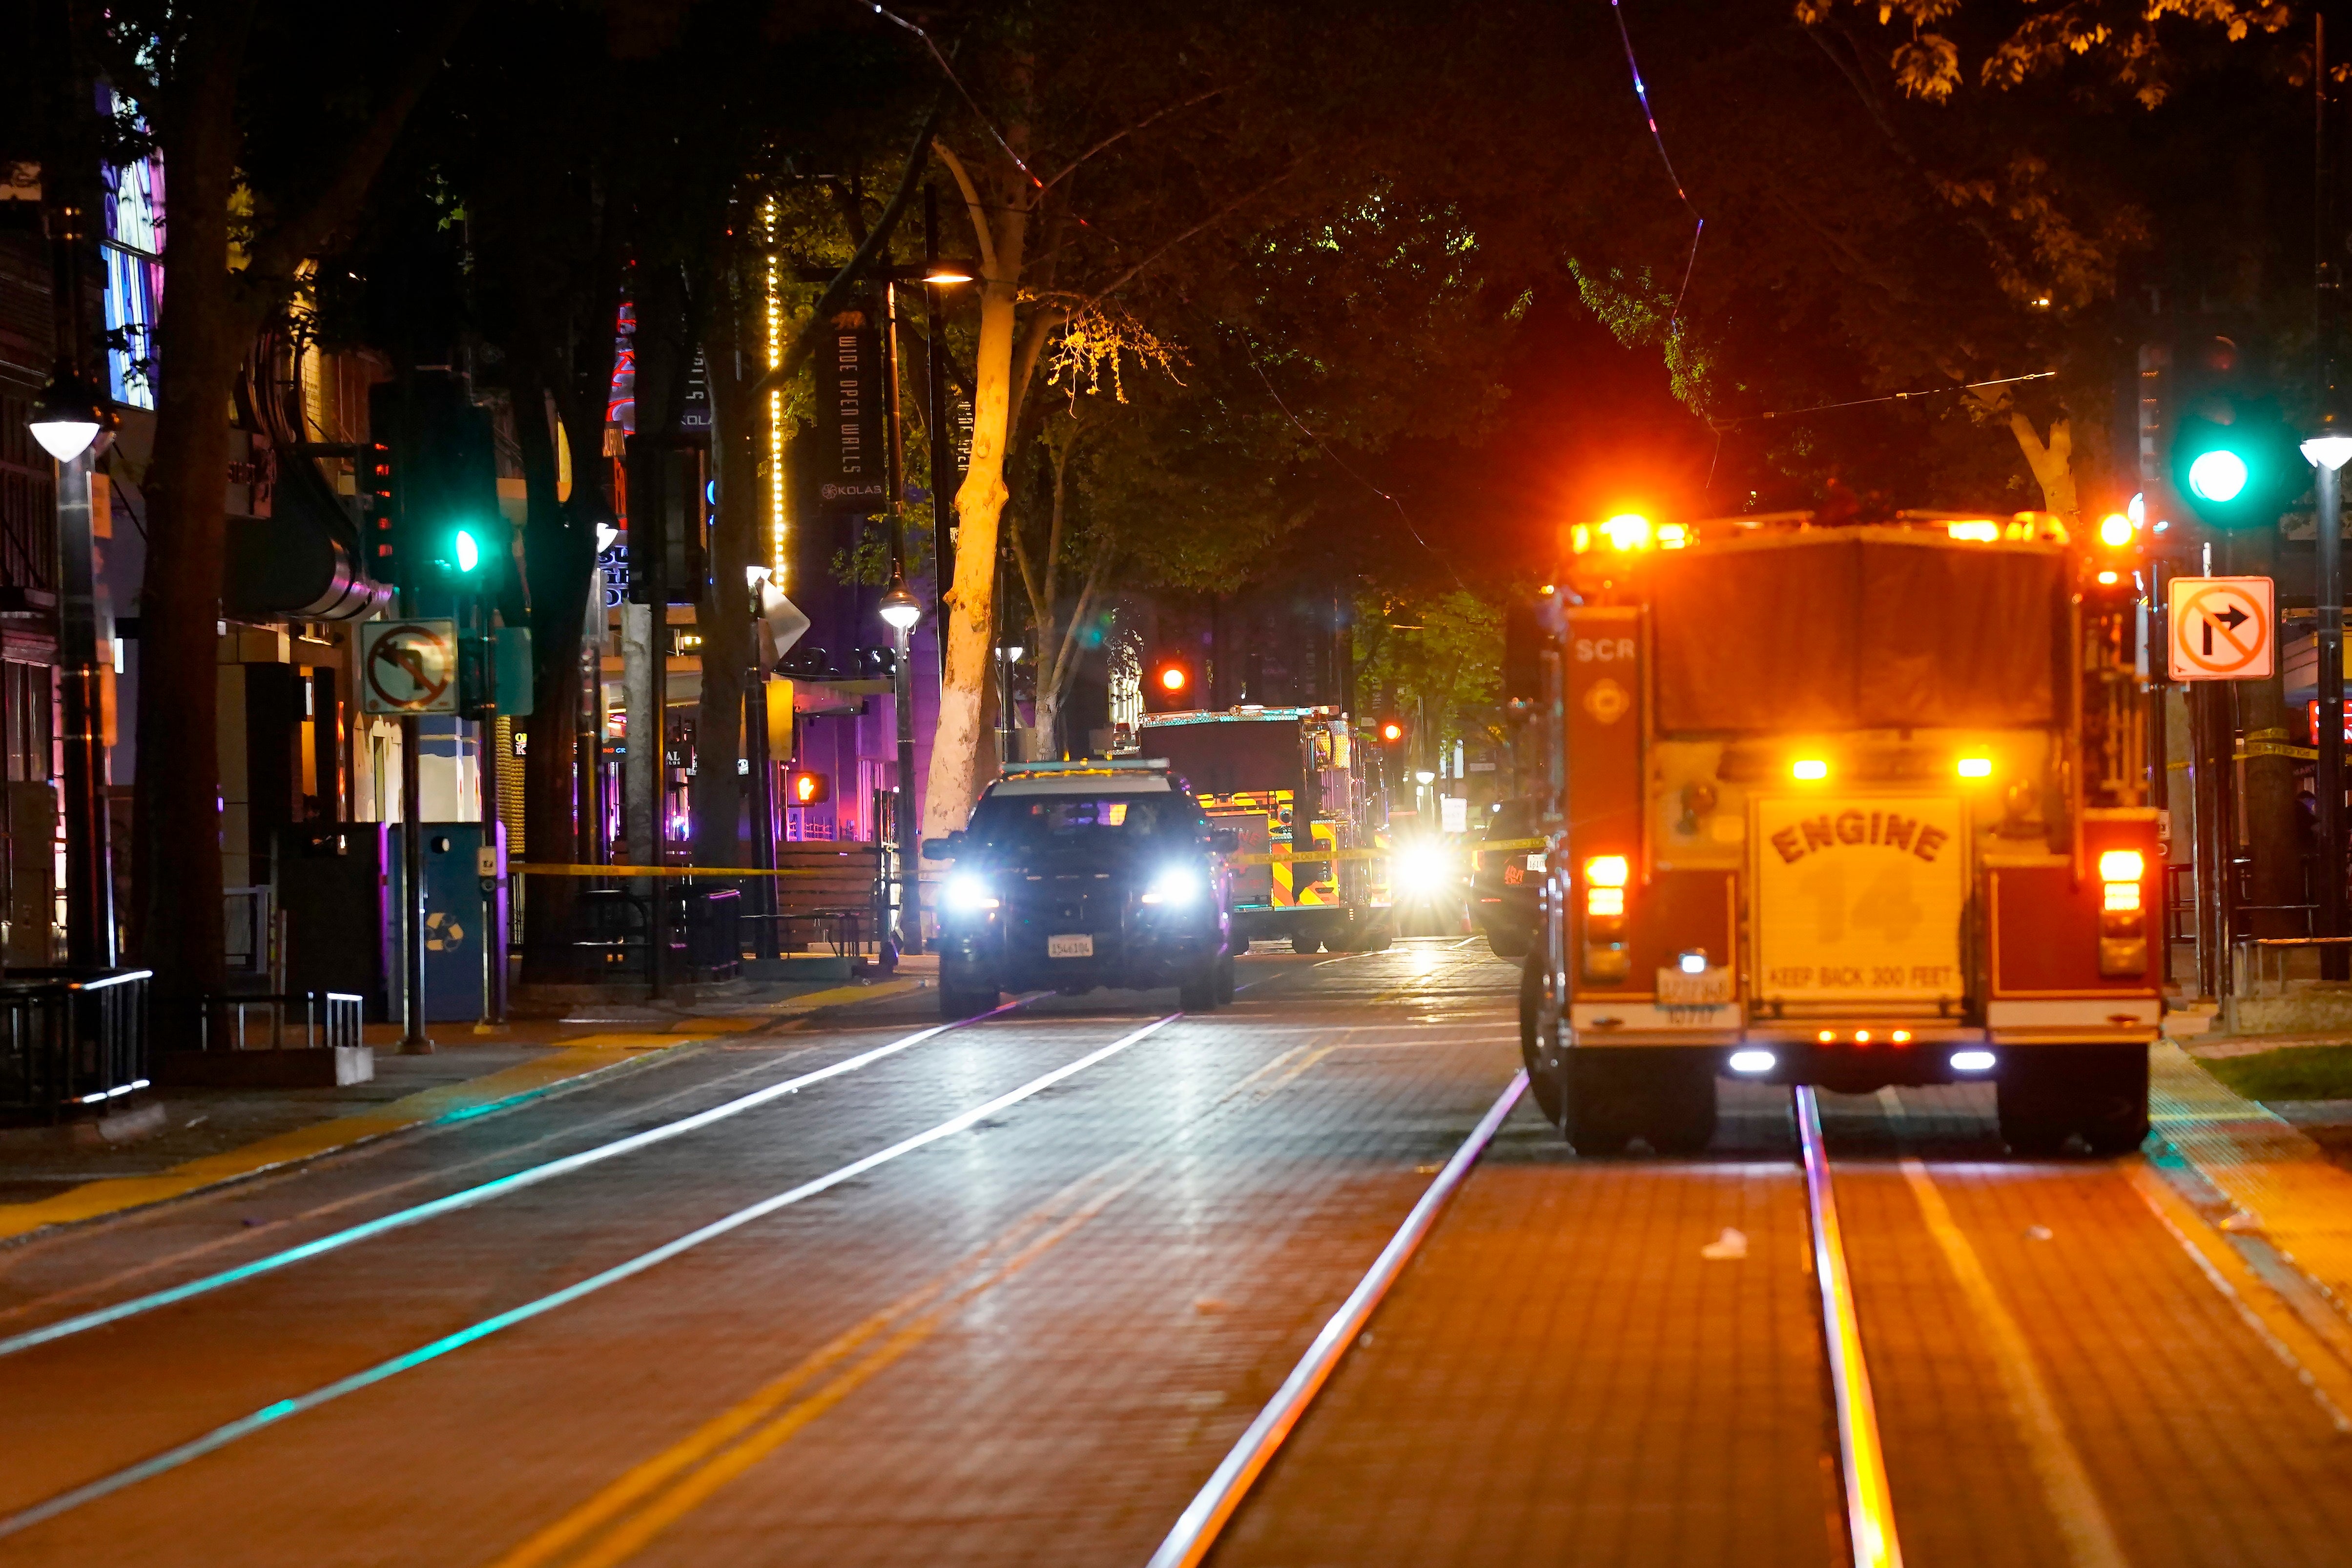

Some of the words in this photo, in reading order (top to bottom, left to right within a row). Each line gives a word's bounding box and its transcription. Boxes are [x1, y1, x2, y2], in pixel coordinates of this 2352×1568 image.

[839, 336, 858, 371] WIDE
[840, 380, 859, 415] OPEN
[841, 424, 861, 473] WALLS
[838, 485, 882, 495] KOLAS
[1576, 639, 1635, 662] SCR
[1771, 808, 1948, 864] ENGINE
[1770, 966, 1813, 988] KEEP
[1820, 966, 1864, 988] BACK
[1872, 966, 1903, 987] 300
[1911, 965, 1951, 987] FEET
